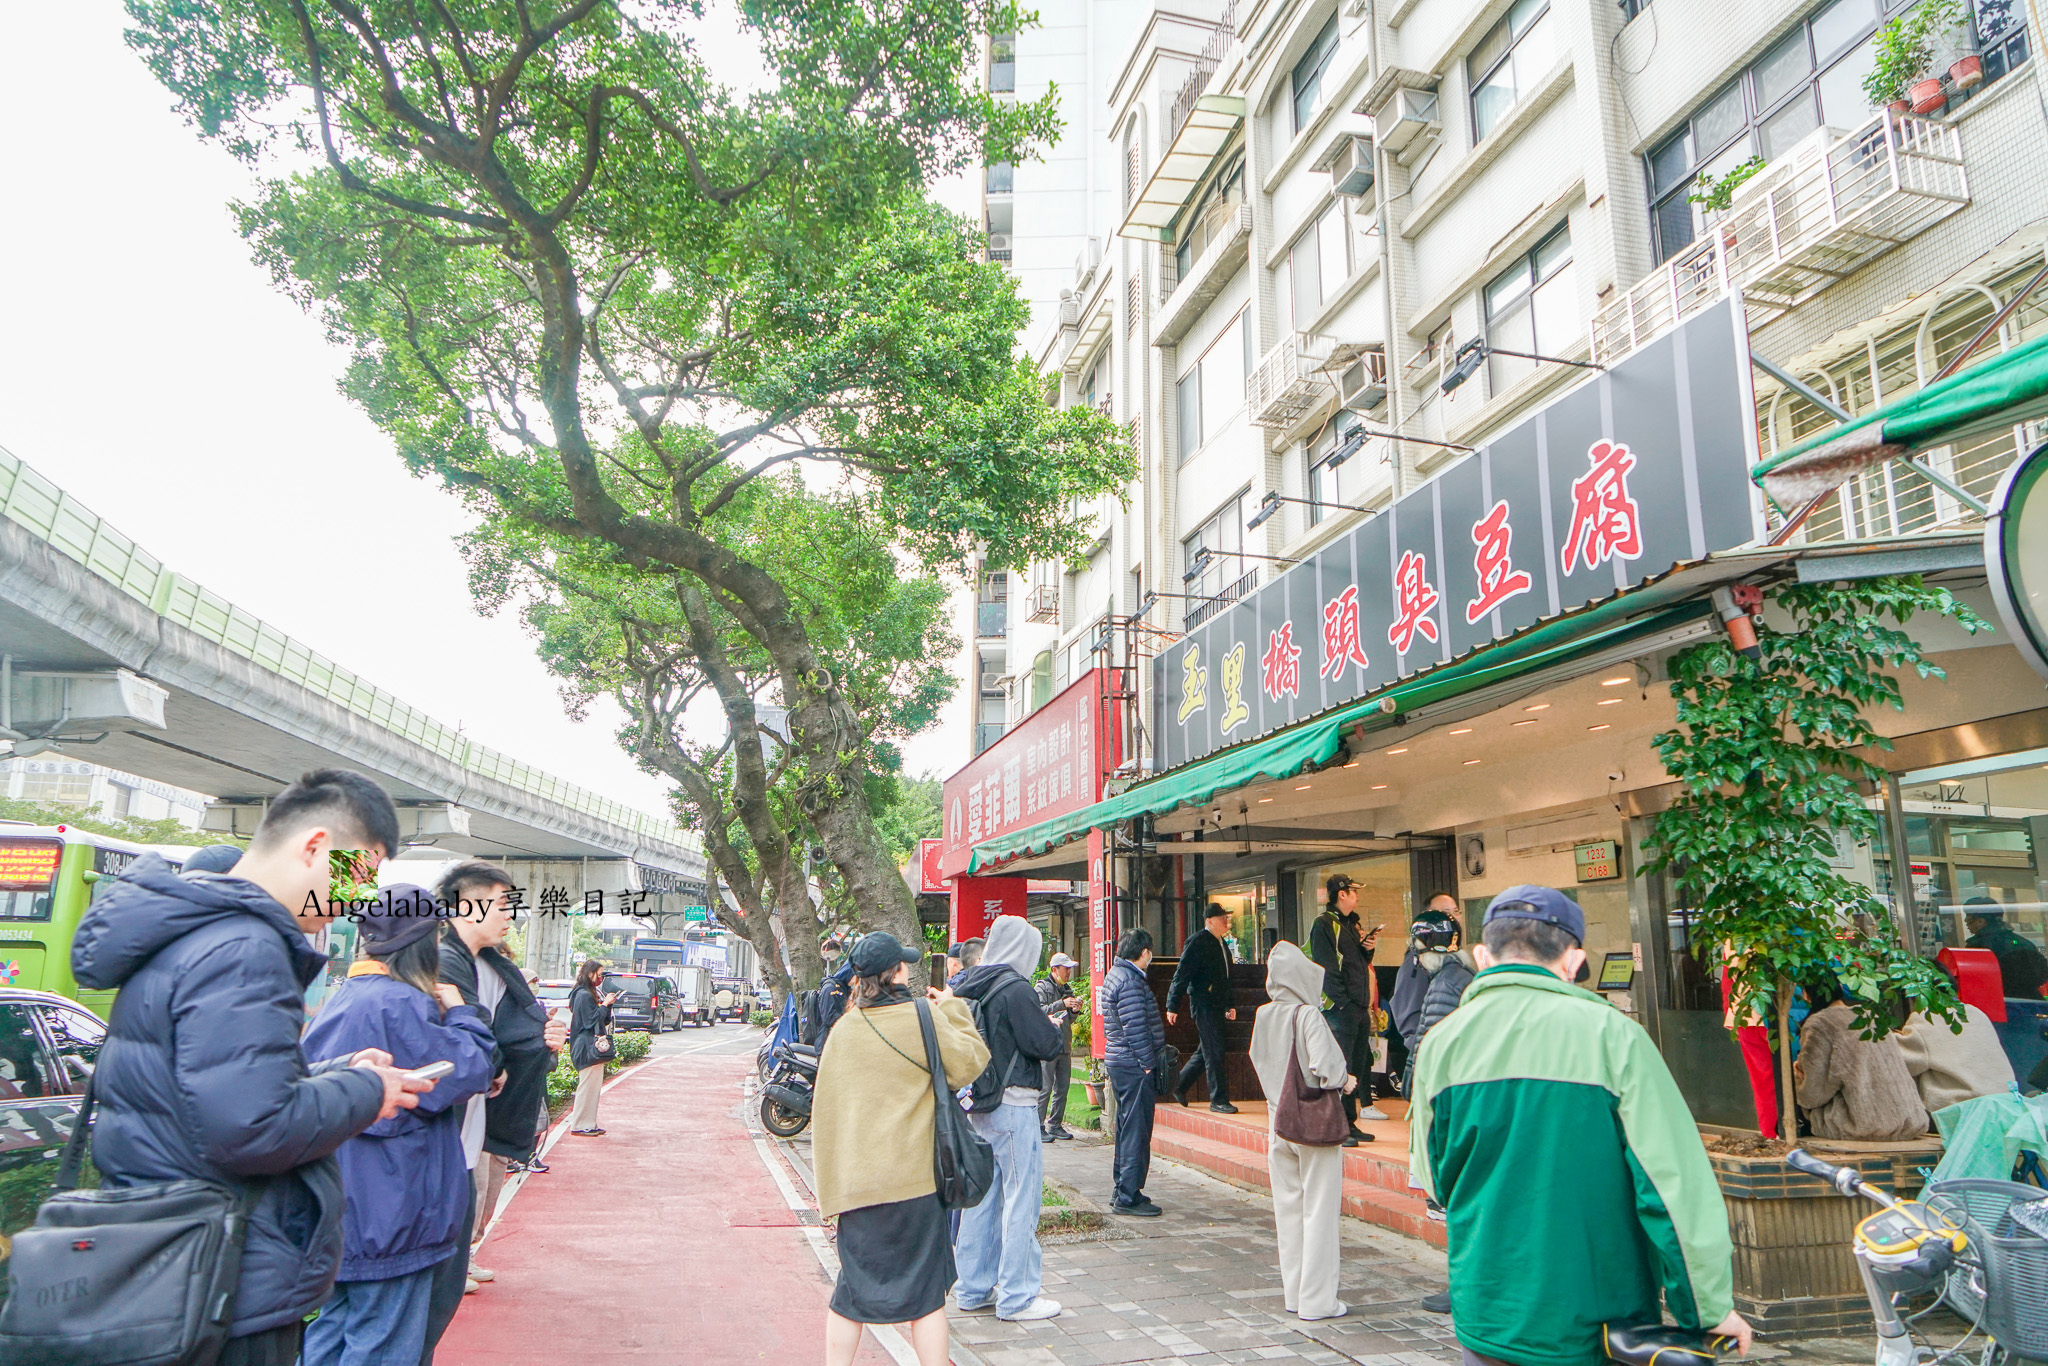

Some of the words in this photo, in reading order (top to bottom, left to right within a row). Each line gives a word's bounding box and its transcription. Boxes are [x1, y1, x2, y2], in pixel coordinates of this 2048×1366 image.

[1177, 438, 1644, 735] 玉里橋頭臭豆腐
[968, 753, 1021, 844] 愛菲爾
[1586, 848, 1606, 860] 1232
[1587, 865, 1608, 878] C168
